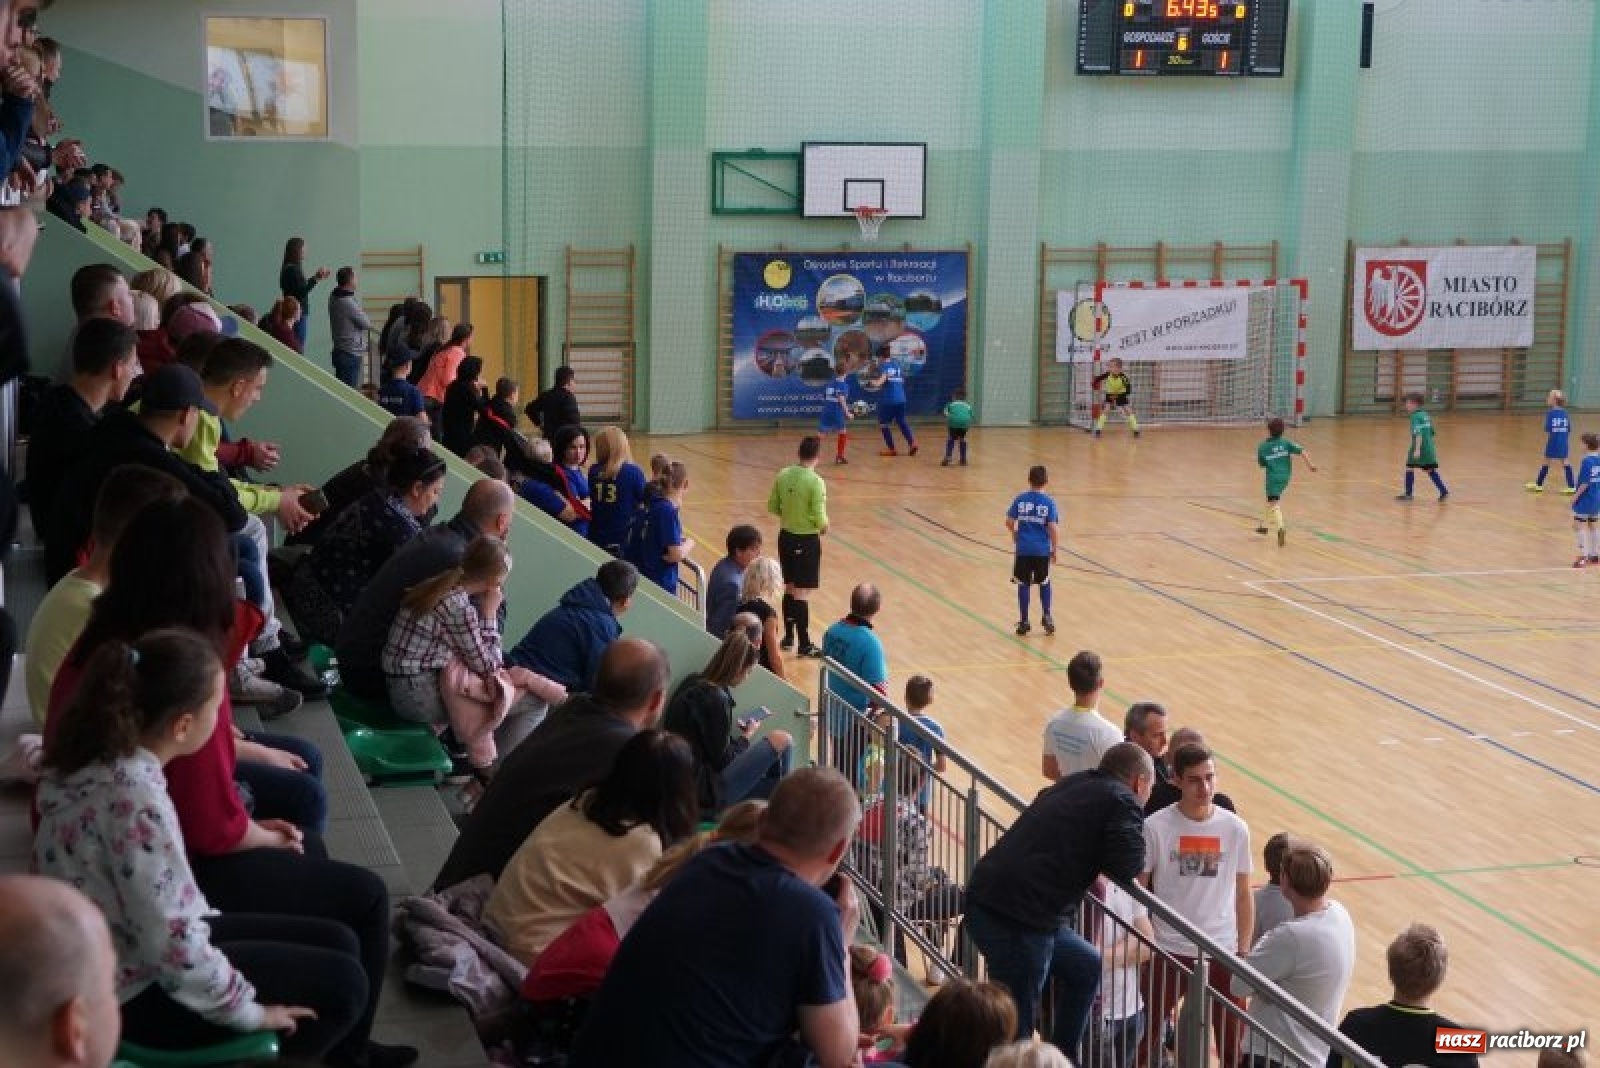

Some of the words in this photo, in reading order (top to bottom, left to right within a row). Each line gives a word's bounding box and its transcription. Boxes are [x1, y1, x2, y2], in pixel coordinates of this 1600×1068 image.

[849, 259, 882, 271] Sportu
[1443, 276, 1518, 293] MIASTO
[1430, 296, 1528, 318] RACIBÓRZ
[1119, 329, 1148, 350] JEST
[1151, 325, 1165, 338] W
[594, 483, 617, 503] 13
[1017, 501, 1034, 513] SP
